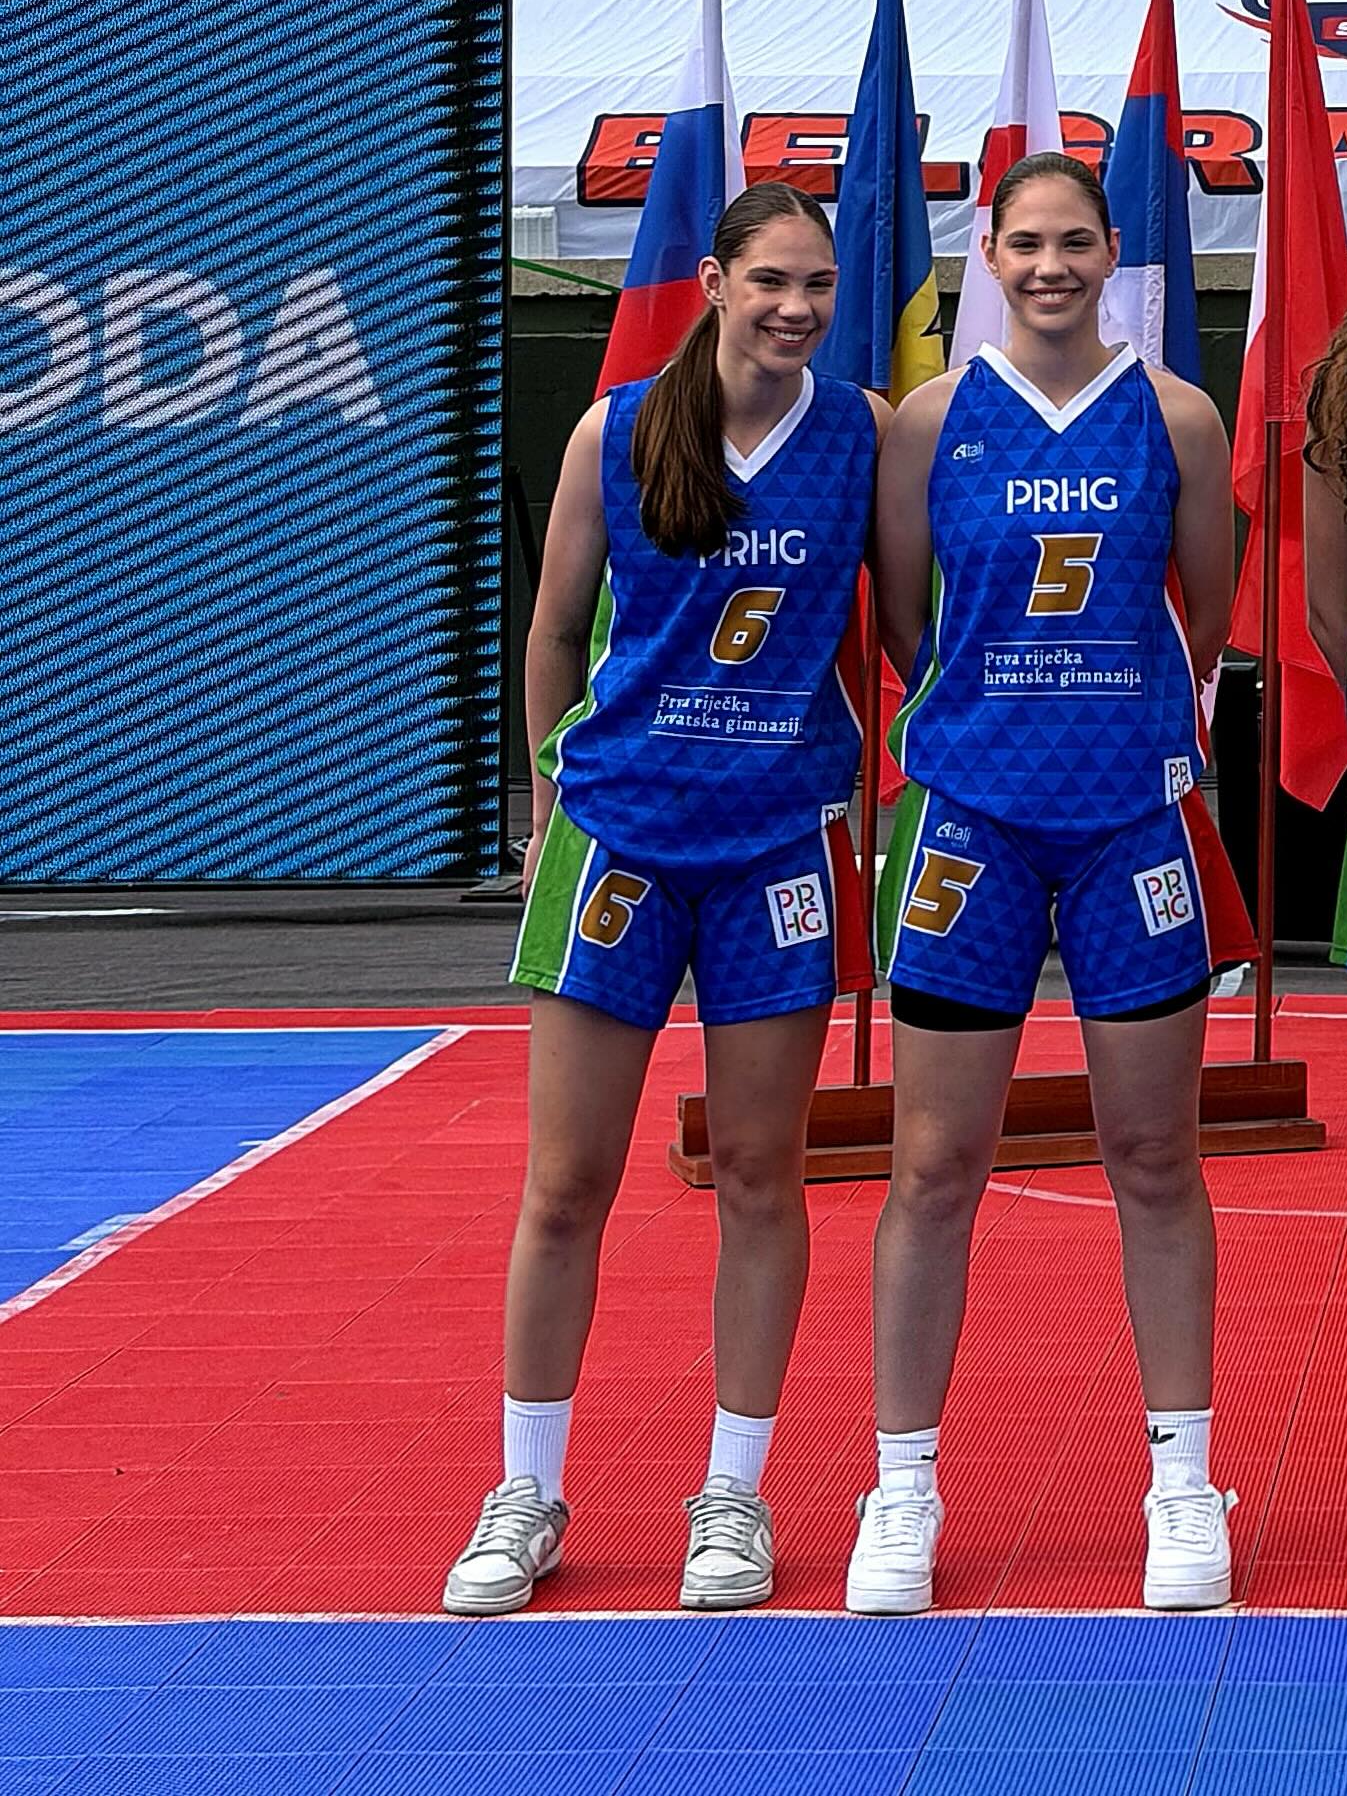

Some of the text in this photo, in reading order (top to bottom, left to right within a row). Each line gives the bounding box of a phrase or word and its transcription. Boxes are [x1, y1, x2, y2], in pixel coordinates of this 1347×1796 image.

[1007, 477, 1118, 513] PRHG
[1025, 533, 1104, 617] 5
[709, 587, 786, 665] 6
[984, 648, 1083, 669] Prva riječka
[984, 668, 1142, 689] hrvatska gimnazija
[695, 694, 750, 714] riječka
[726, 715, 804, 737] gimnazij
[774, 883, 816, 915] PR
[902, 847, 986, 937] 5
[1143, 869, 1182, 903] PR
[578, 869, 653, 949] 6
[780, 908, 822, 940] HG
[1151, 893, 1188, 929] HG
